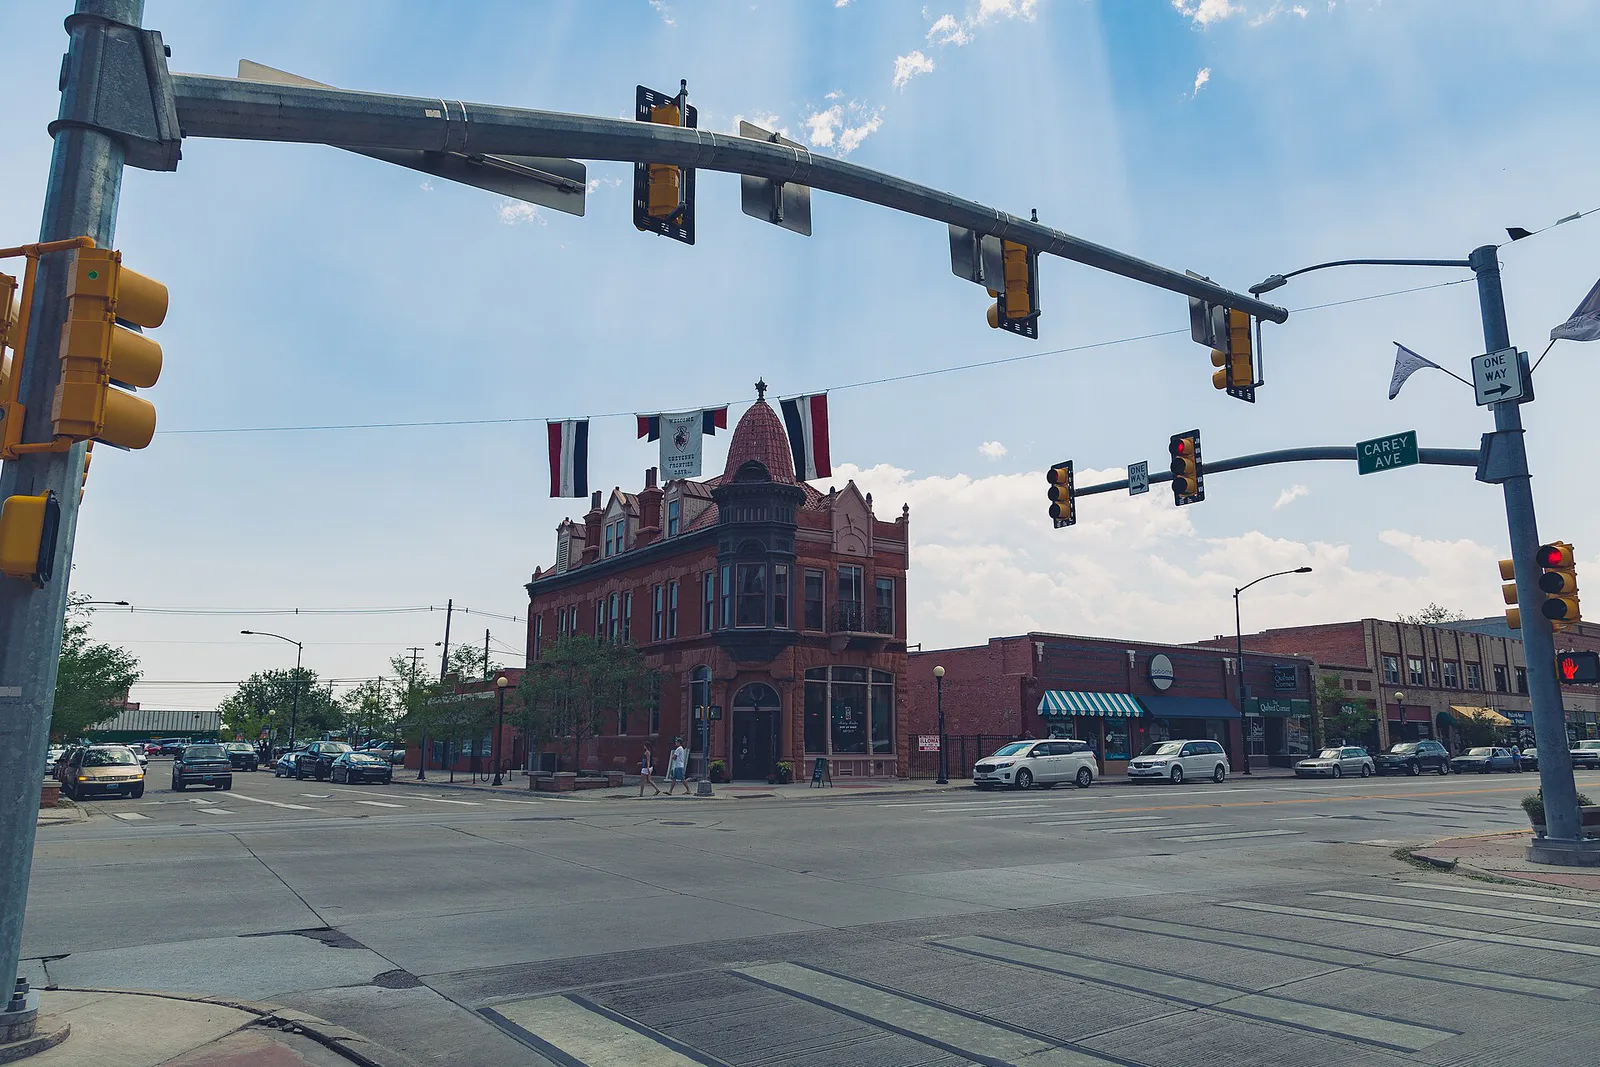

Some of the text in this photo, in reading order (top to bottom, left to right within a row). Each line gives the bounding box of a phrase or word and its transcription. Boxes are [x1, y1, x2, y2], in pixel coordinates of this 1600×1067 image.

[1484, 354, 1506, 369] ONE
[1485, 368, 1507, 382] WAY
[1364, 436, 1408, 456] CAREY
[1375, 452, 1401, 468] AVE
[1131, 465, 1145, 474] ONE
[1131, 473, 1145, 482] WAY
